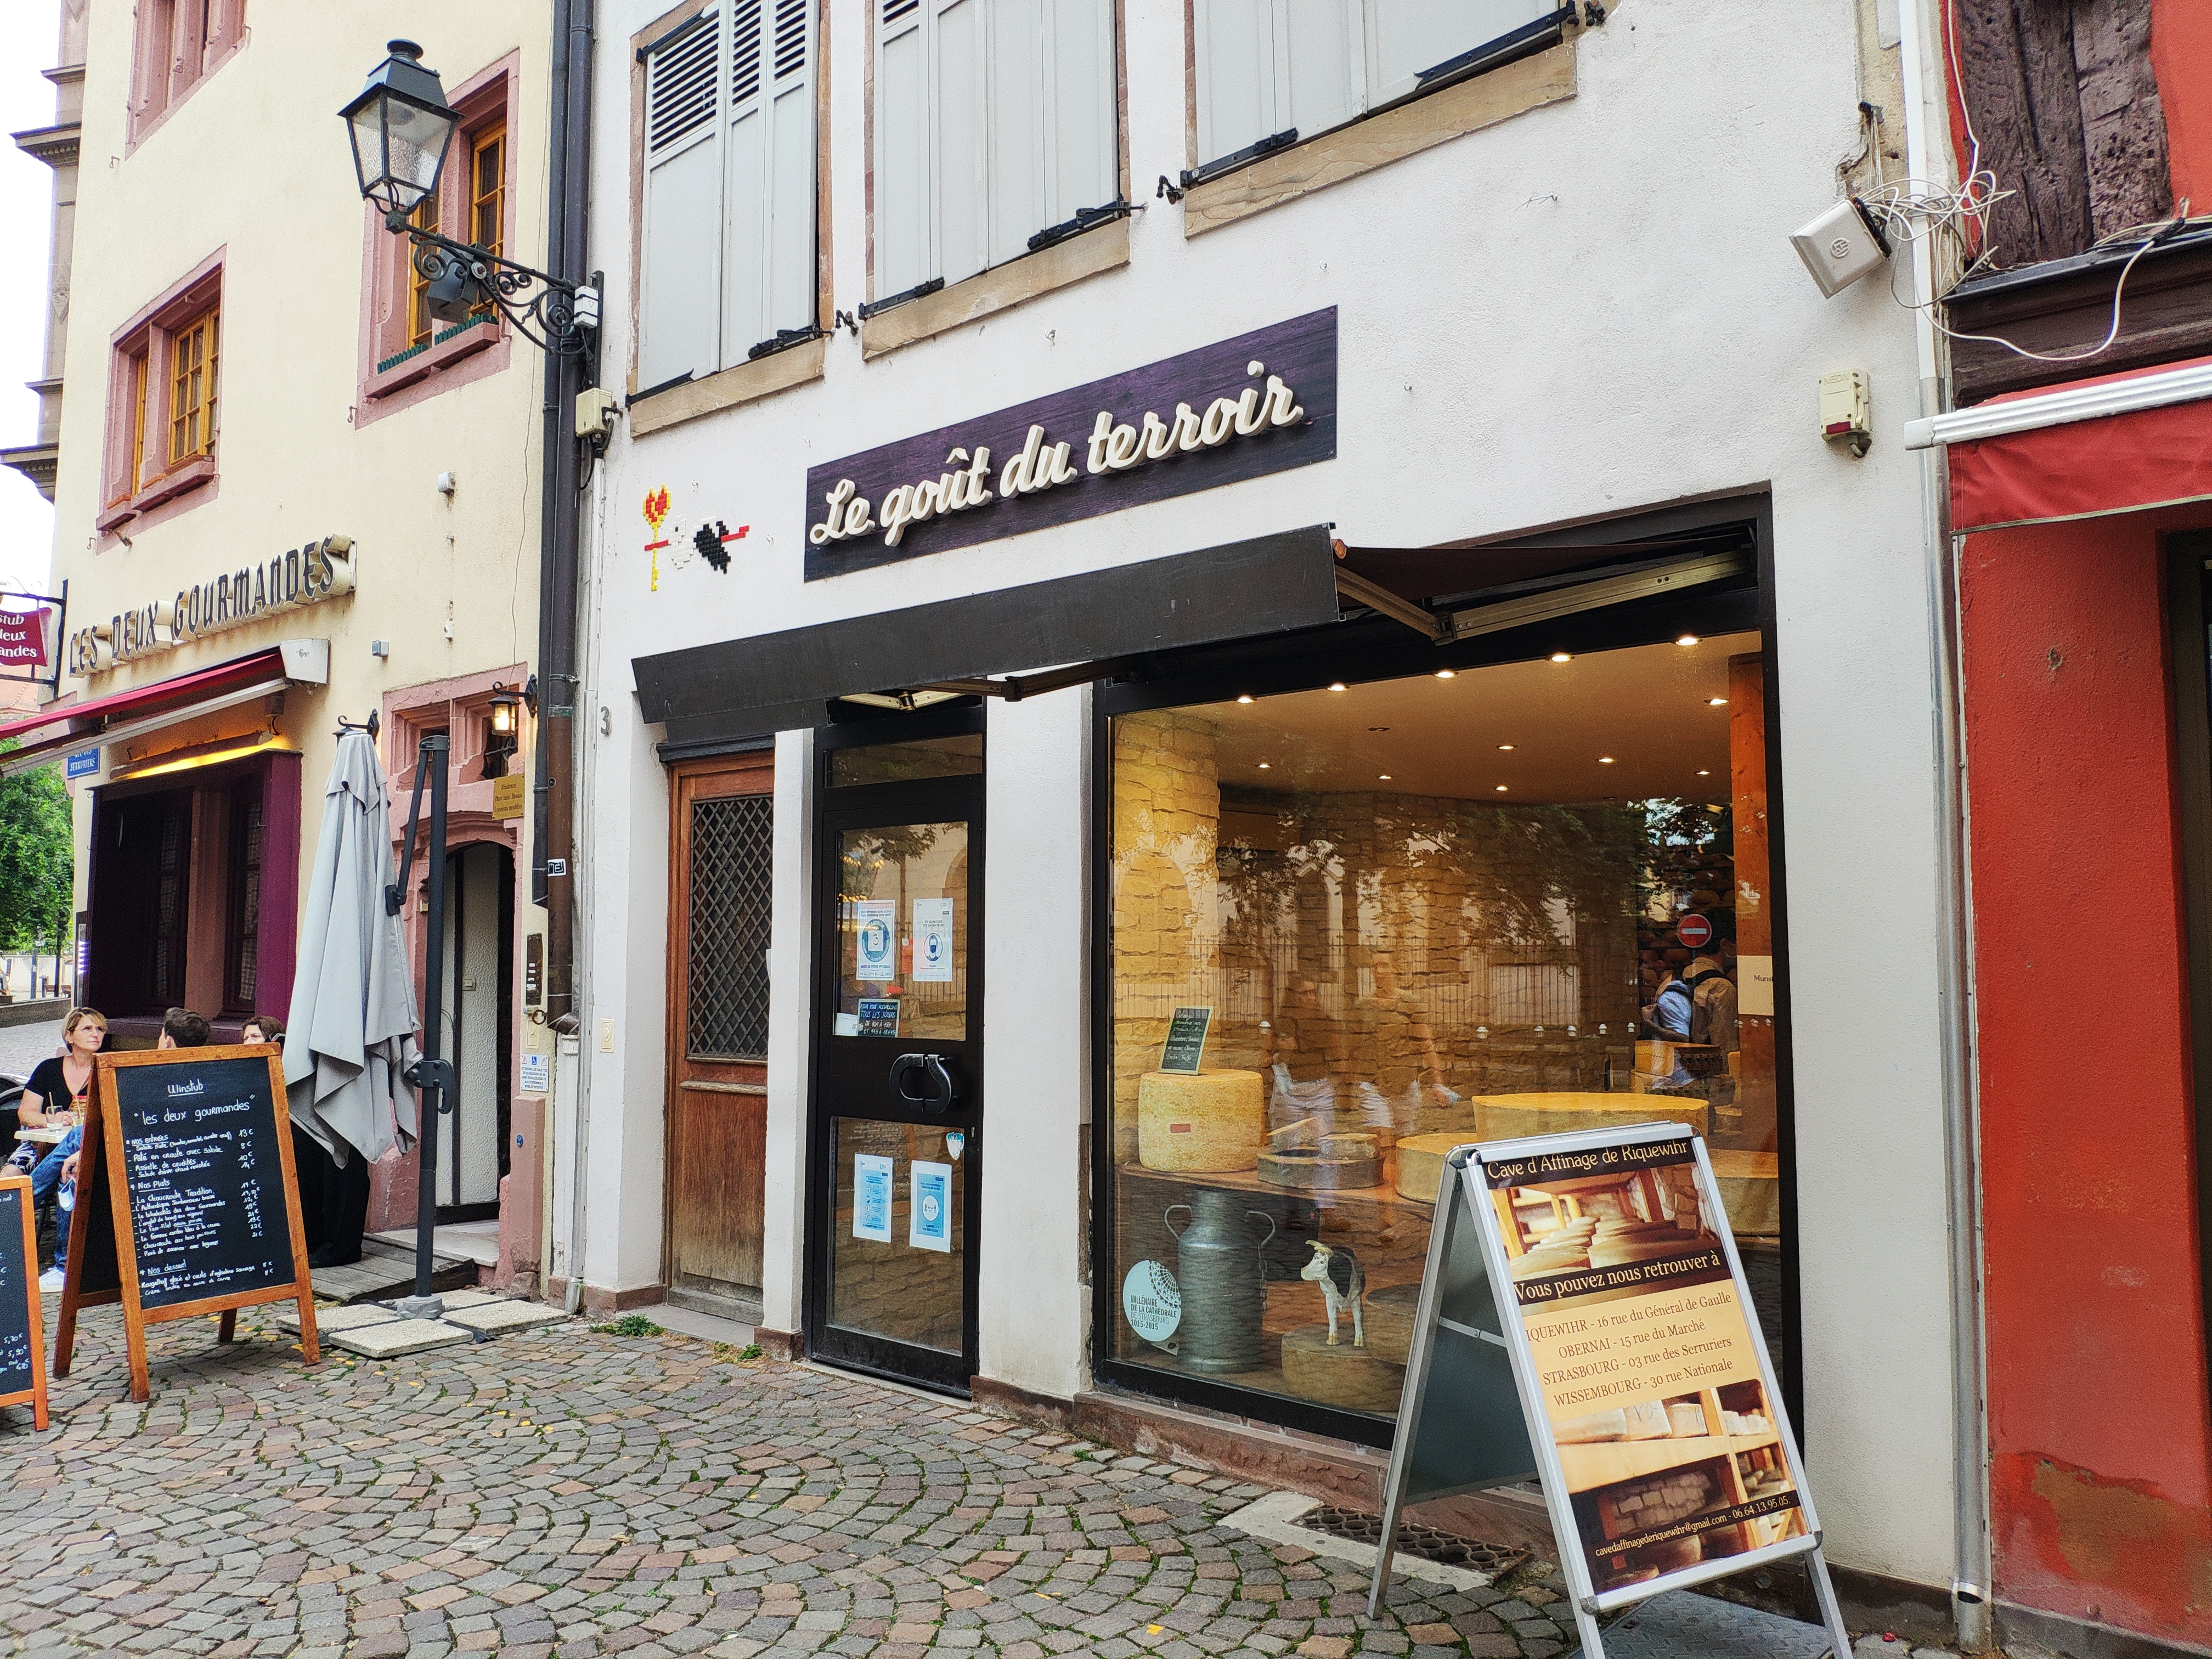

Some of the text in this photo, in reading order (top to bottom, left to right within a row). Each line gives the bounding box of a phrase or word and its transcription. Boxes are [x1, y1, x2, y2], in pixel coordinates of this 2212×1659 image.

[809, 360, 1304, 548] Le goût du terroir
[70, 535, 334, 675] LES DEUX GOURMANDES
[0, 629, 27, 641] eux
[601, 706, 610, 736] 3
[168, 1079, 204, 1093] Winstub
[164, 1108, 186, 1122] deux
[1488, 1161, 1523, 1178] Cave
[1602, 1147, 1618, 1163] de
[1622, 1141, 1688, 1163] Riquewihr
[1514, 1250, 1720, 1301] Vous pouvez nous retrouver à
[1131, 1295, 1158, 1306] MILLÉNAIRE
[1138, 1313, 1169, 1324] STRASBOURG
[1146, 1306, 1177, 1318] CATHÉDRALE
[1598, 1314, 1609, 1328] 16
[1611, 1315, 1628, 1325] rue
[1630, 1309, 1644, 1322] du
[1645, 1300, 1684, 1318] Général
[1686, 1298, 1698, 1312] de
[1699, 1291, 1732, 1308] Gaulle
[1559, 1318, 1706, 1359] OBERNAI 15 rue du Marché
[1543, 1338, 1732, 1385] STRASBOURG 03 rue des Serruriers
[1553, 1358, 1734, 1407] WISSEMBOURG 30 rue Nationale
